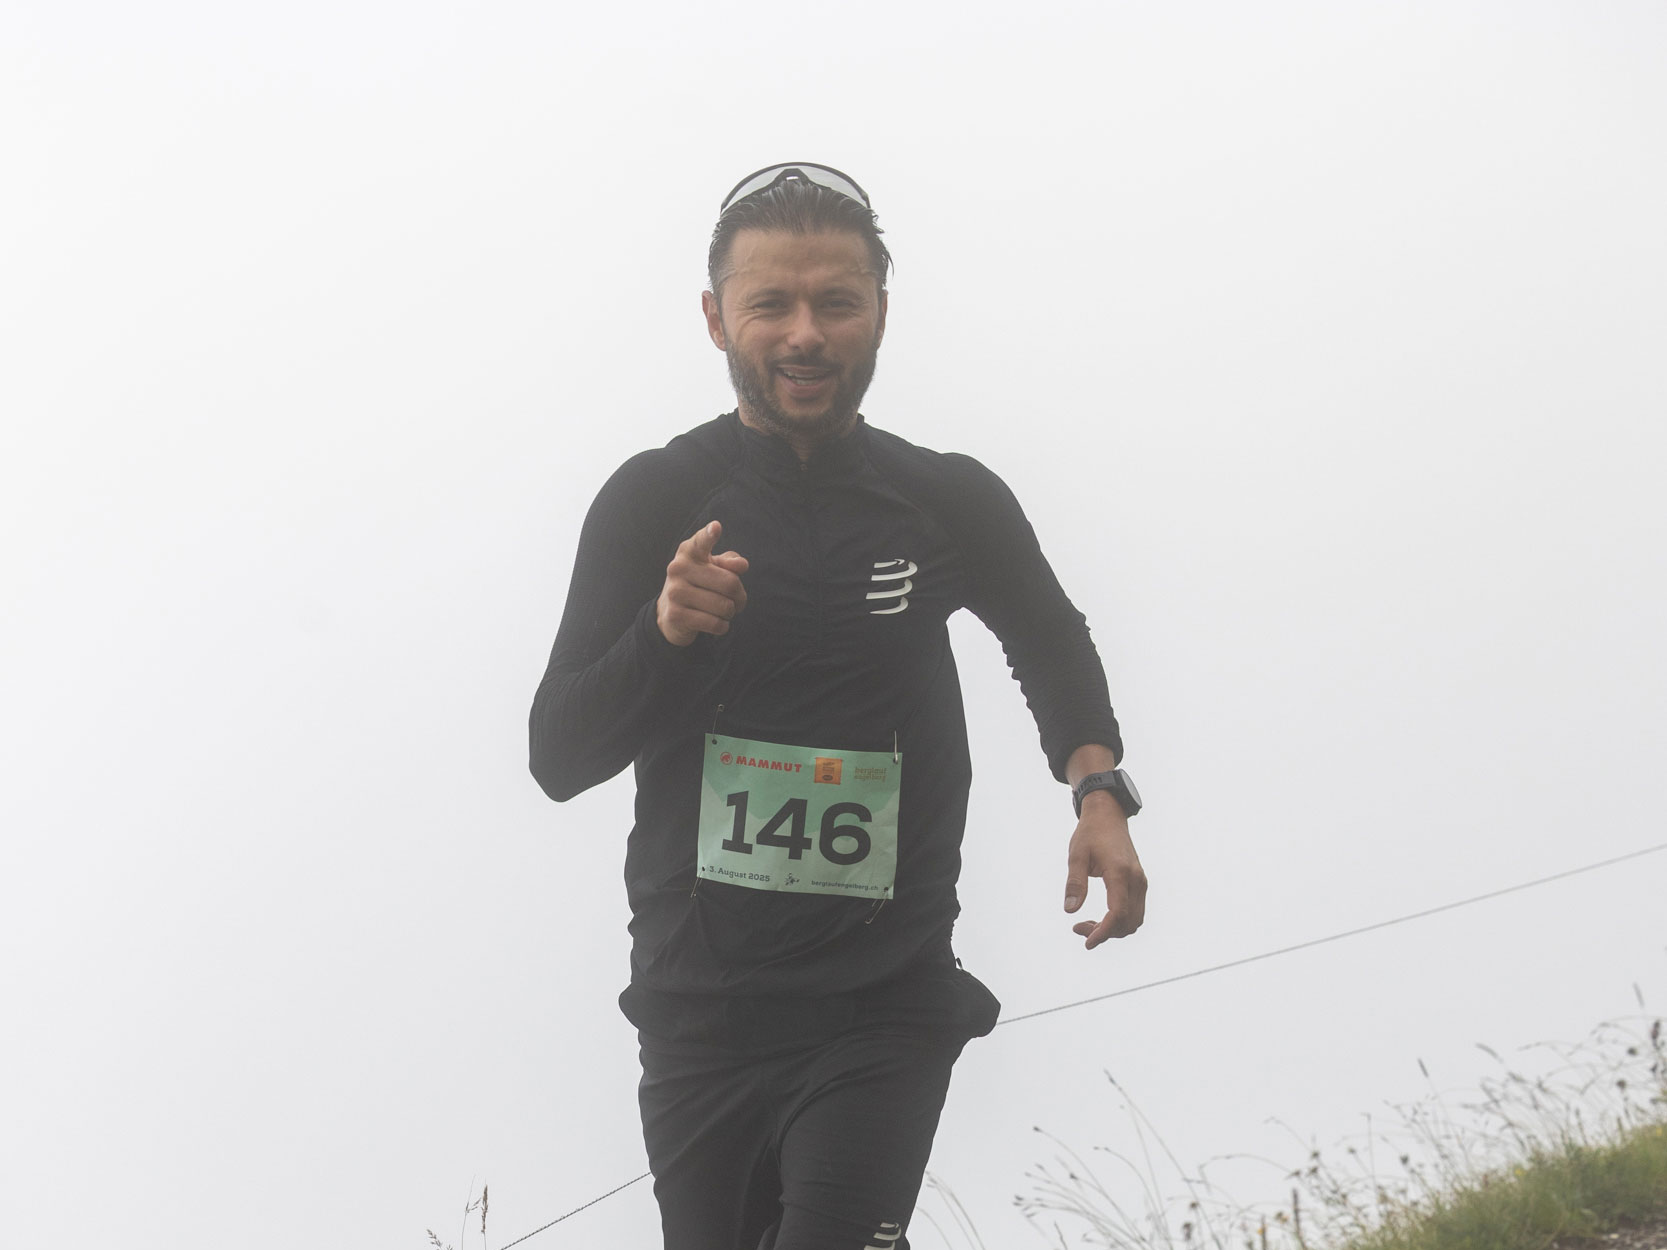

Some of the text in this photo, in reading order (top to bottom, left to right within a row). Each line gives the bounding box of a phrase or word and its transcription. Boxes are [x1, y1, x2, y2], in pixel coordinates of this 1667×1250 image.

[736, 756, 802, 772] MAMMUT
[721, 790, 873, 866] 146
[709, 865, 770, 882] 3. August 2025
